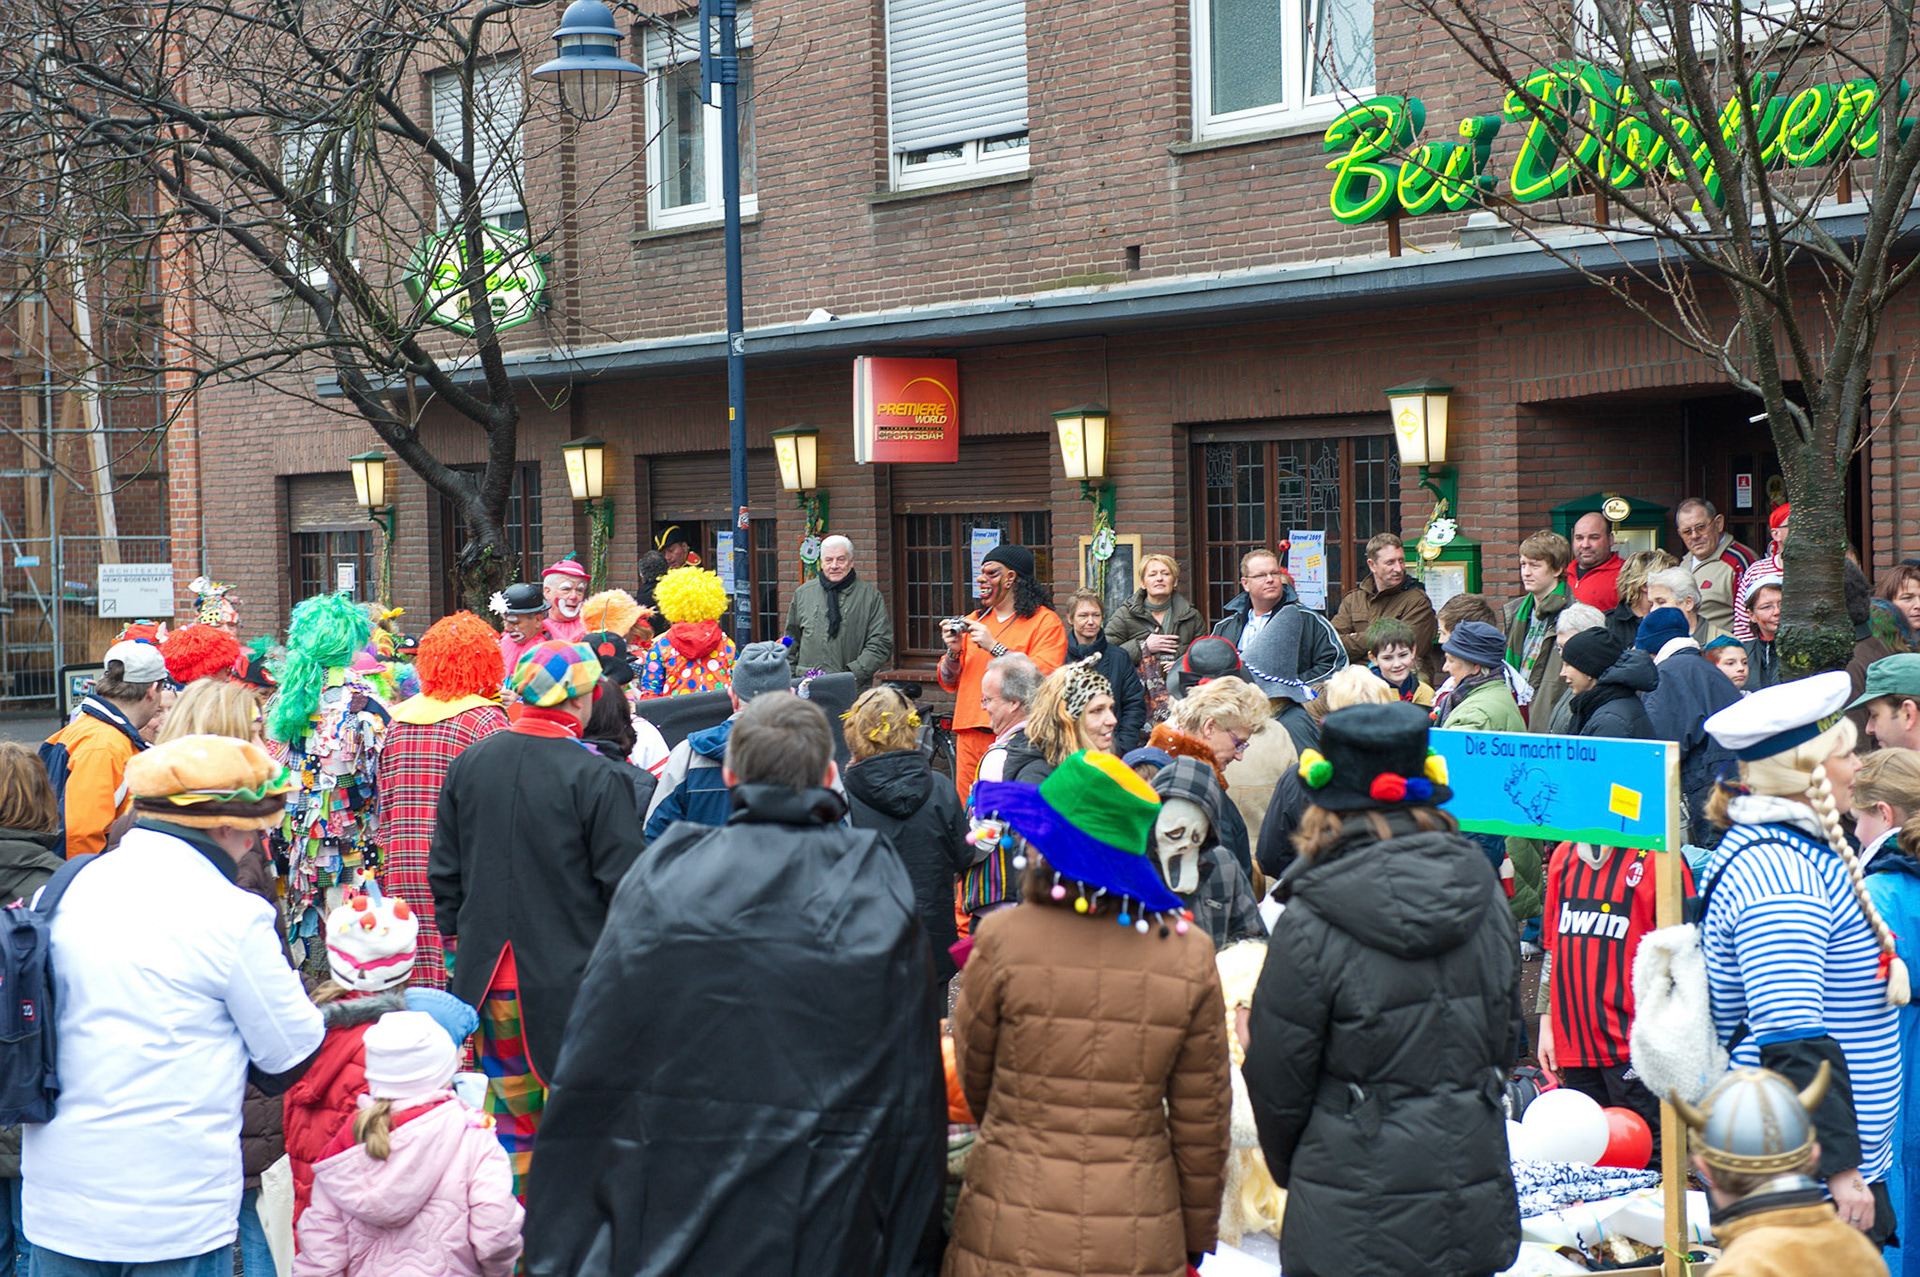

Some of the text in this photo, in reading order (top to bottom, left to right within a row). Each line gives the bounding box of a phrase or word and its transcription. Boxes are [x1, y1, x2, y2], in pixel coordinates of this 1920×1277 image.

[1323, 96, 1499, 225] Bei
[877, 403, 947, 416] PREMIERE
[915, 415, 947, 423] WORLD
[878, 430, 944, 440] SPORTSBAR
[1465, 735, 1597, 762] Die Sau macht blau
[1558, 901, 1630, 939] bwin
